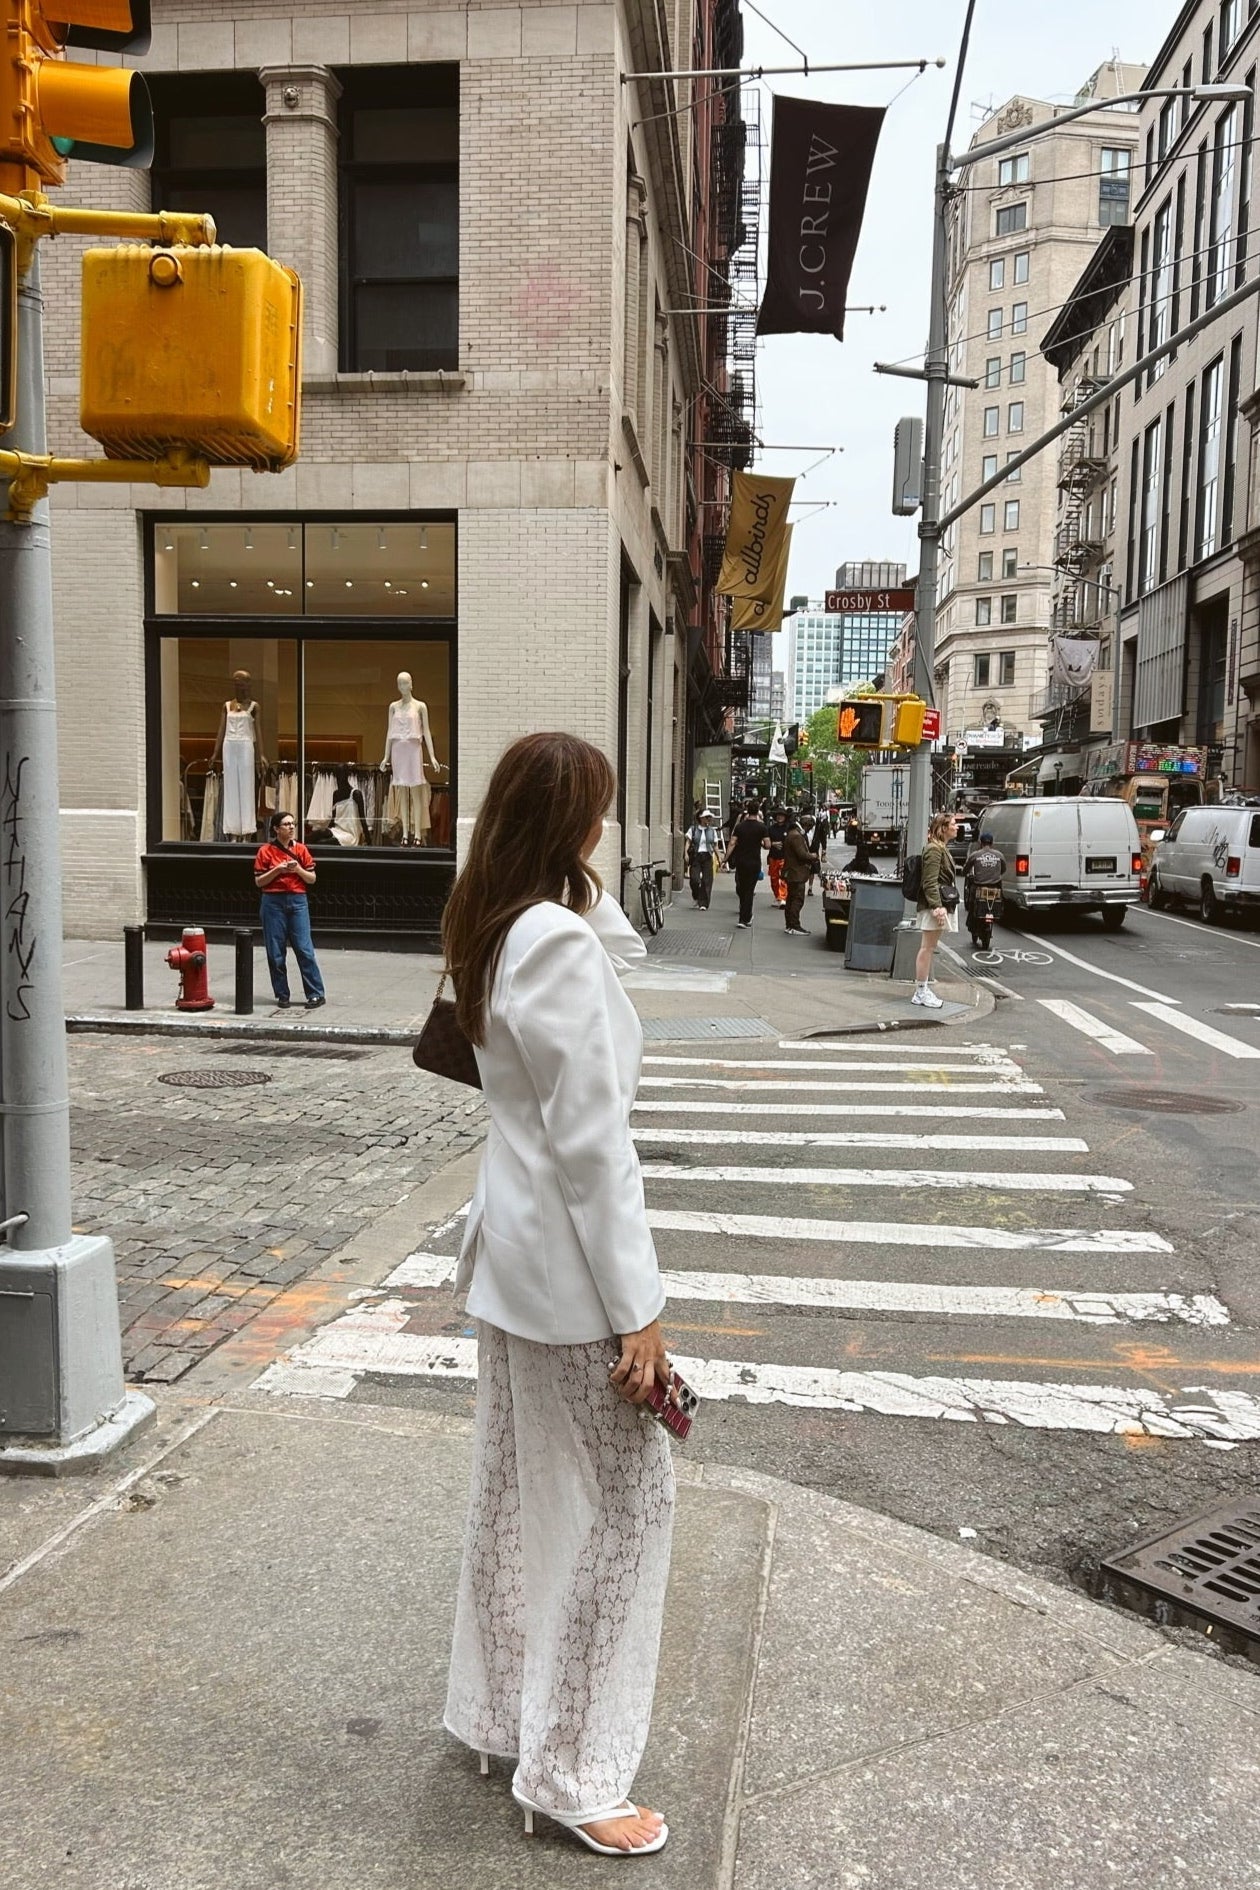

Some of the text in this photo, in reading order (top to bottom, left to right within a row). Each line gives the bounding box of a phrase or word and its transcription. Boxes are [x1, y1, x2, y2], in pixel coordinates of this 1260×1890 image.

[799, 133, 839, 310] J.CREW
[740, 493, 776, 585] allbirds
[827, 594, 890, 611] Crosby St
